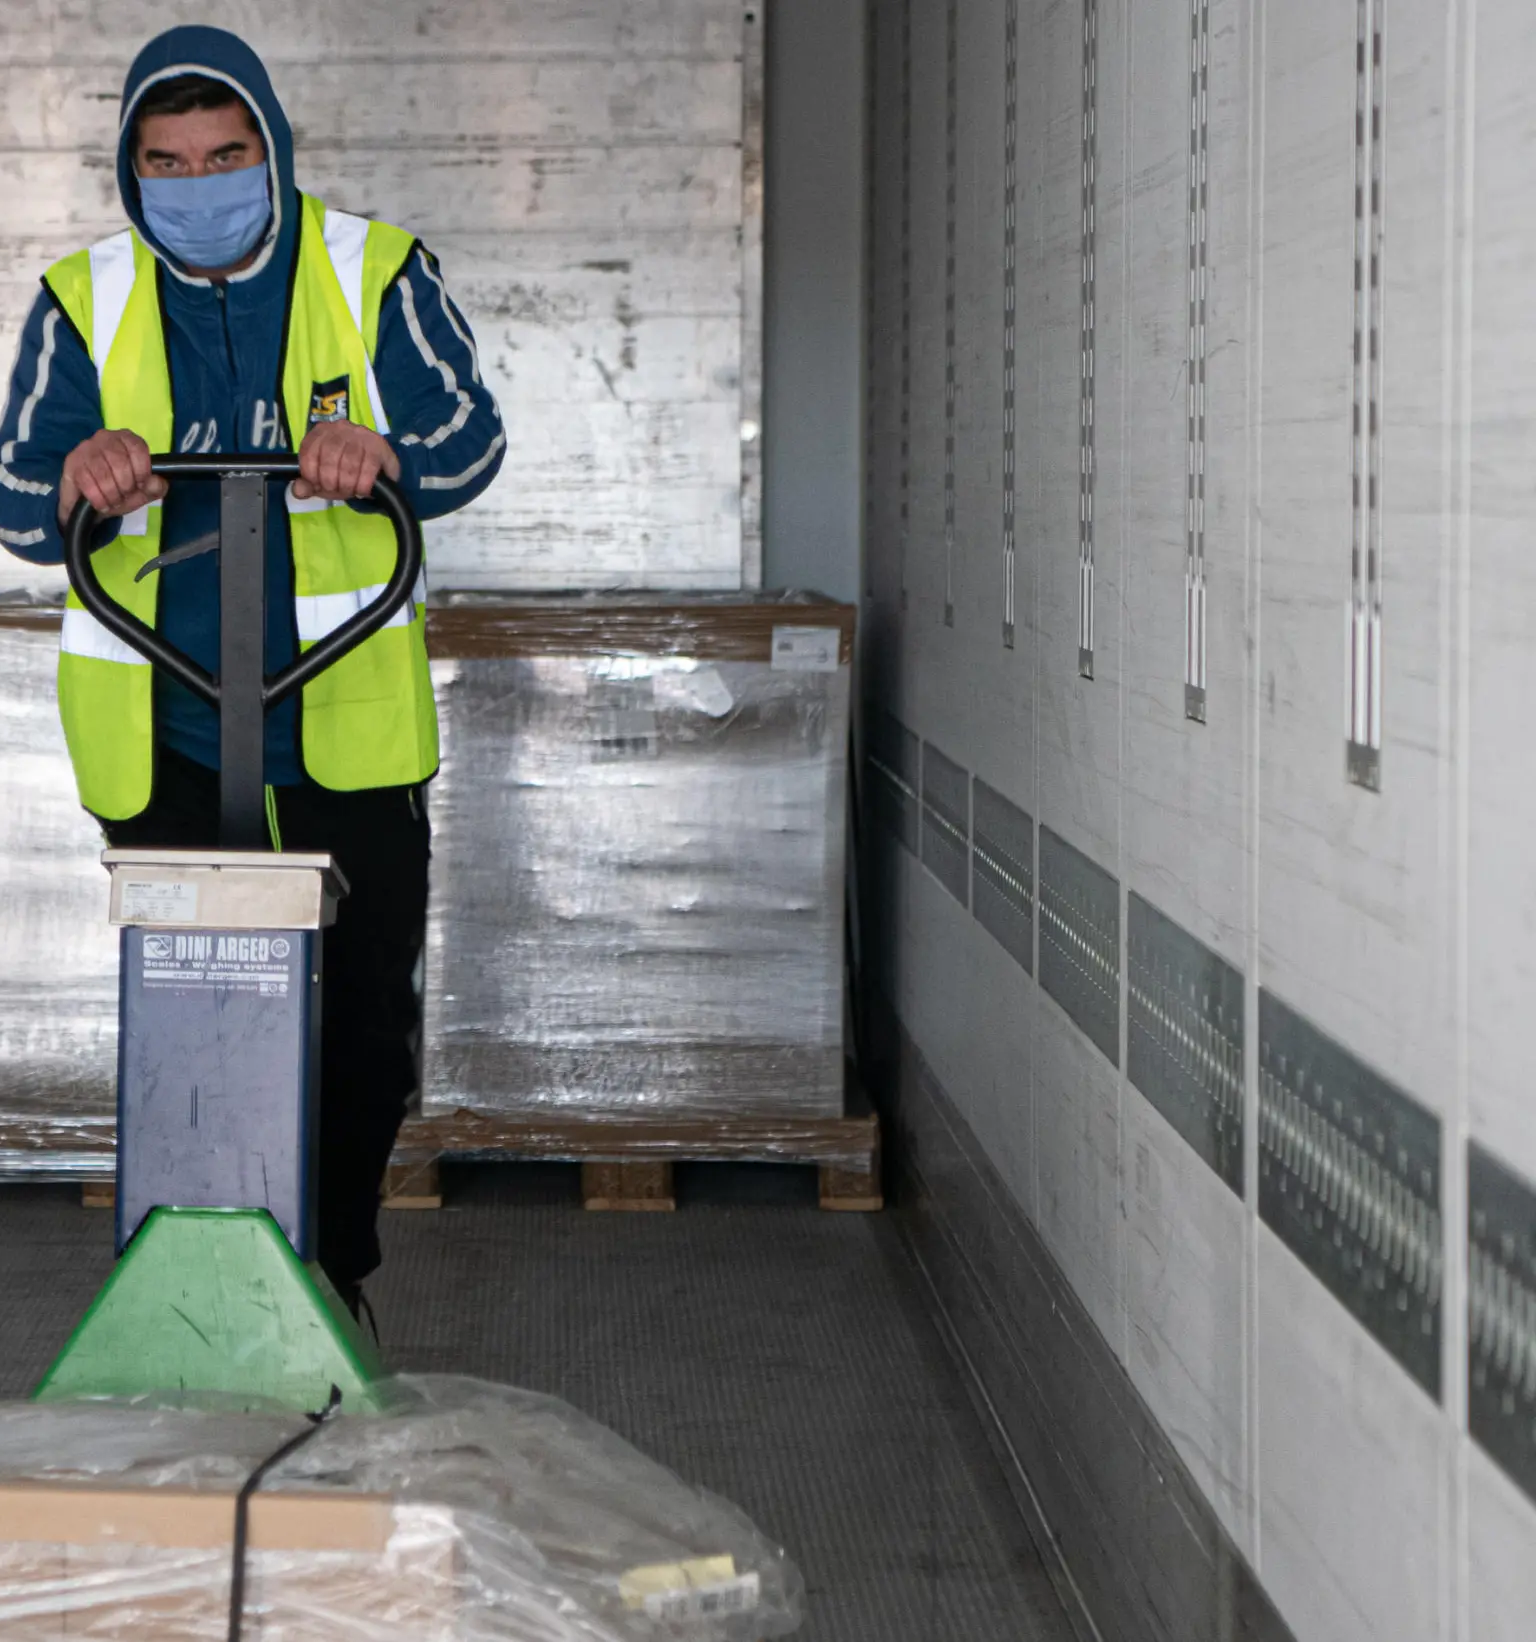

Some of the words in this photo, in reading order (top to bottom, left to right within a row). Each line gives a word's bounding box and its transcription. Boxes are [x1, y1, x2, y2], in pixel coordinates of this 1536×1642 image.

[175, 935, 212, 961] DINI
[216, 936, 269, 962] ARGEO
[144, 960, 180, 969] Scales
[191, 961, 240, 971] Weghing
[244, 963, 289, 972] systems
